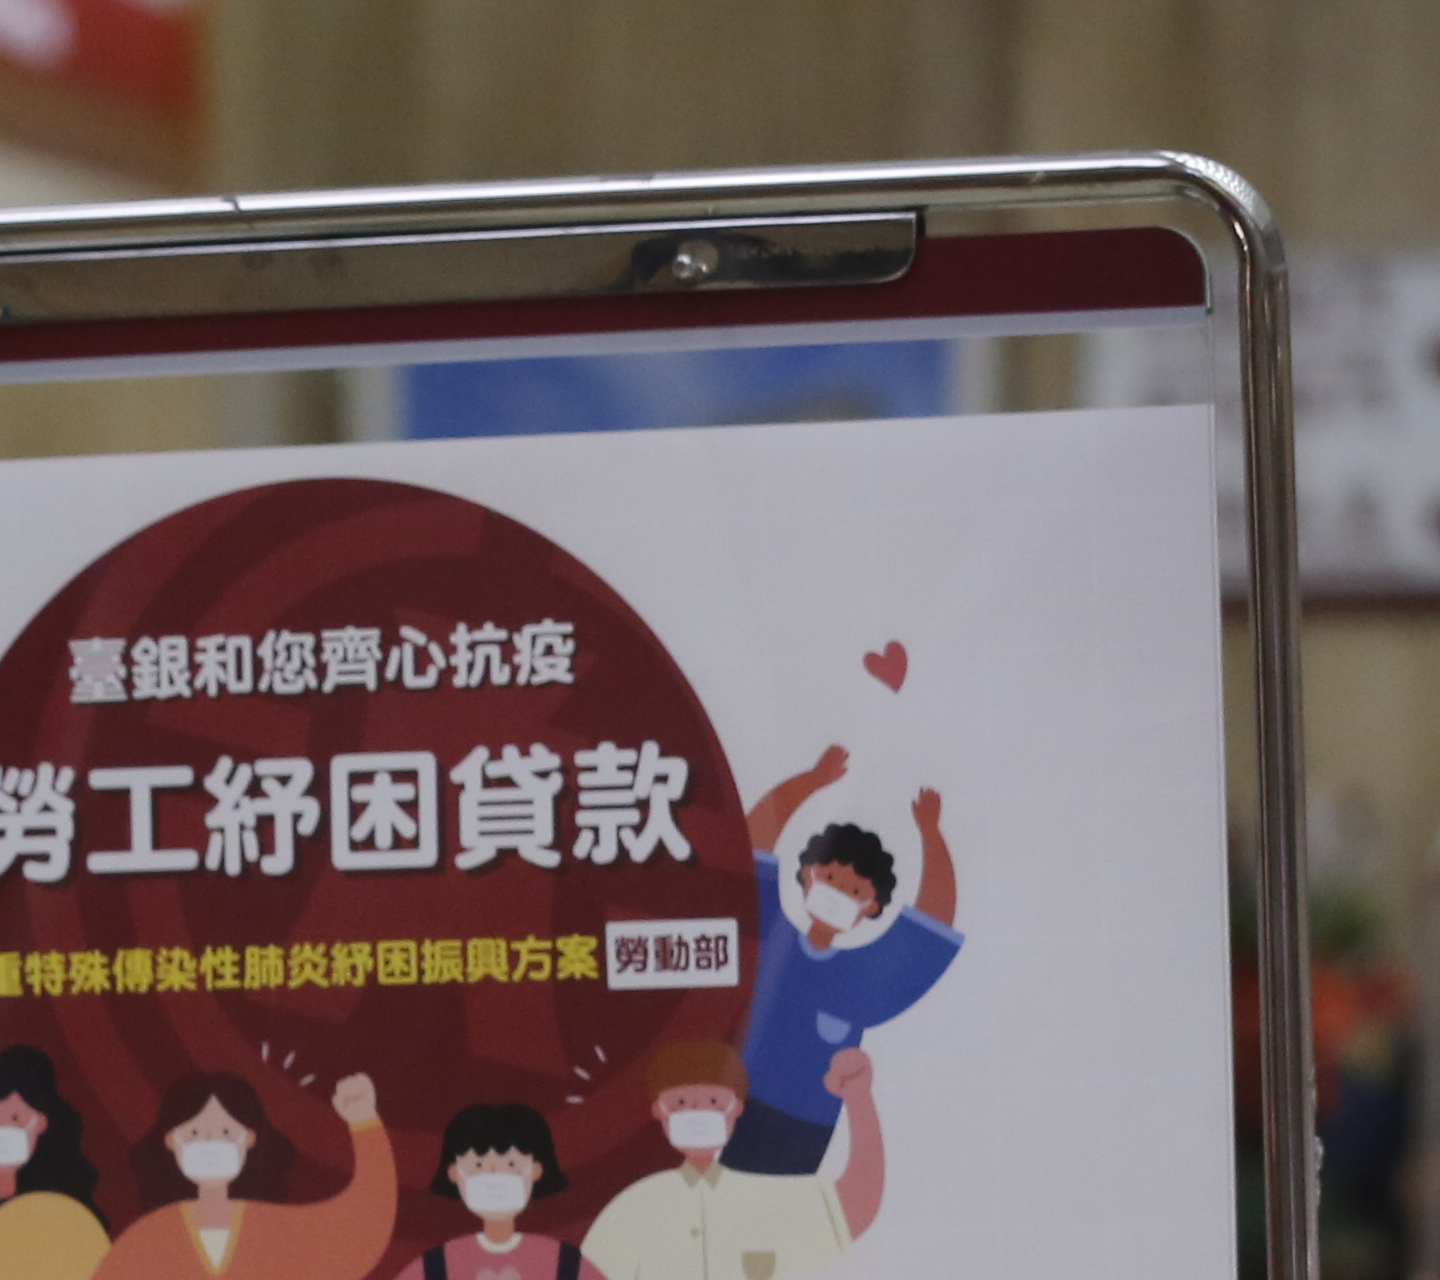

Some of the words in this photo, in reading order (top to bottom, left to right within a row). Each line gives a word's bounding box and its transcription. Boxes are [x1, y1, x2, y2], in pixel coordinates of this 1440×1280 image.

[68, 619, 575, 704] 臺銀和您齊心抗疫
[614, 933, 729, 974] 勞動部
